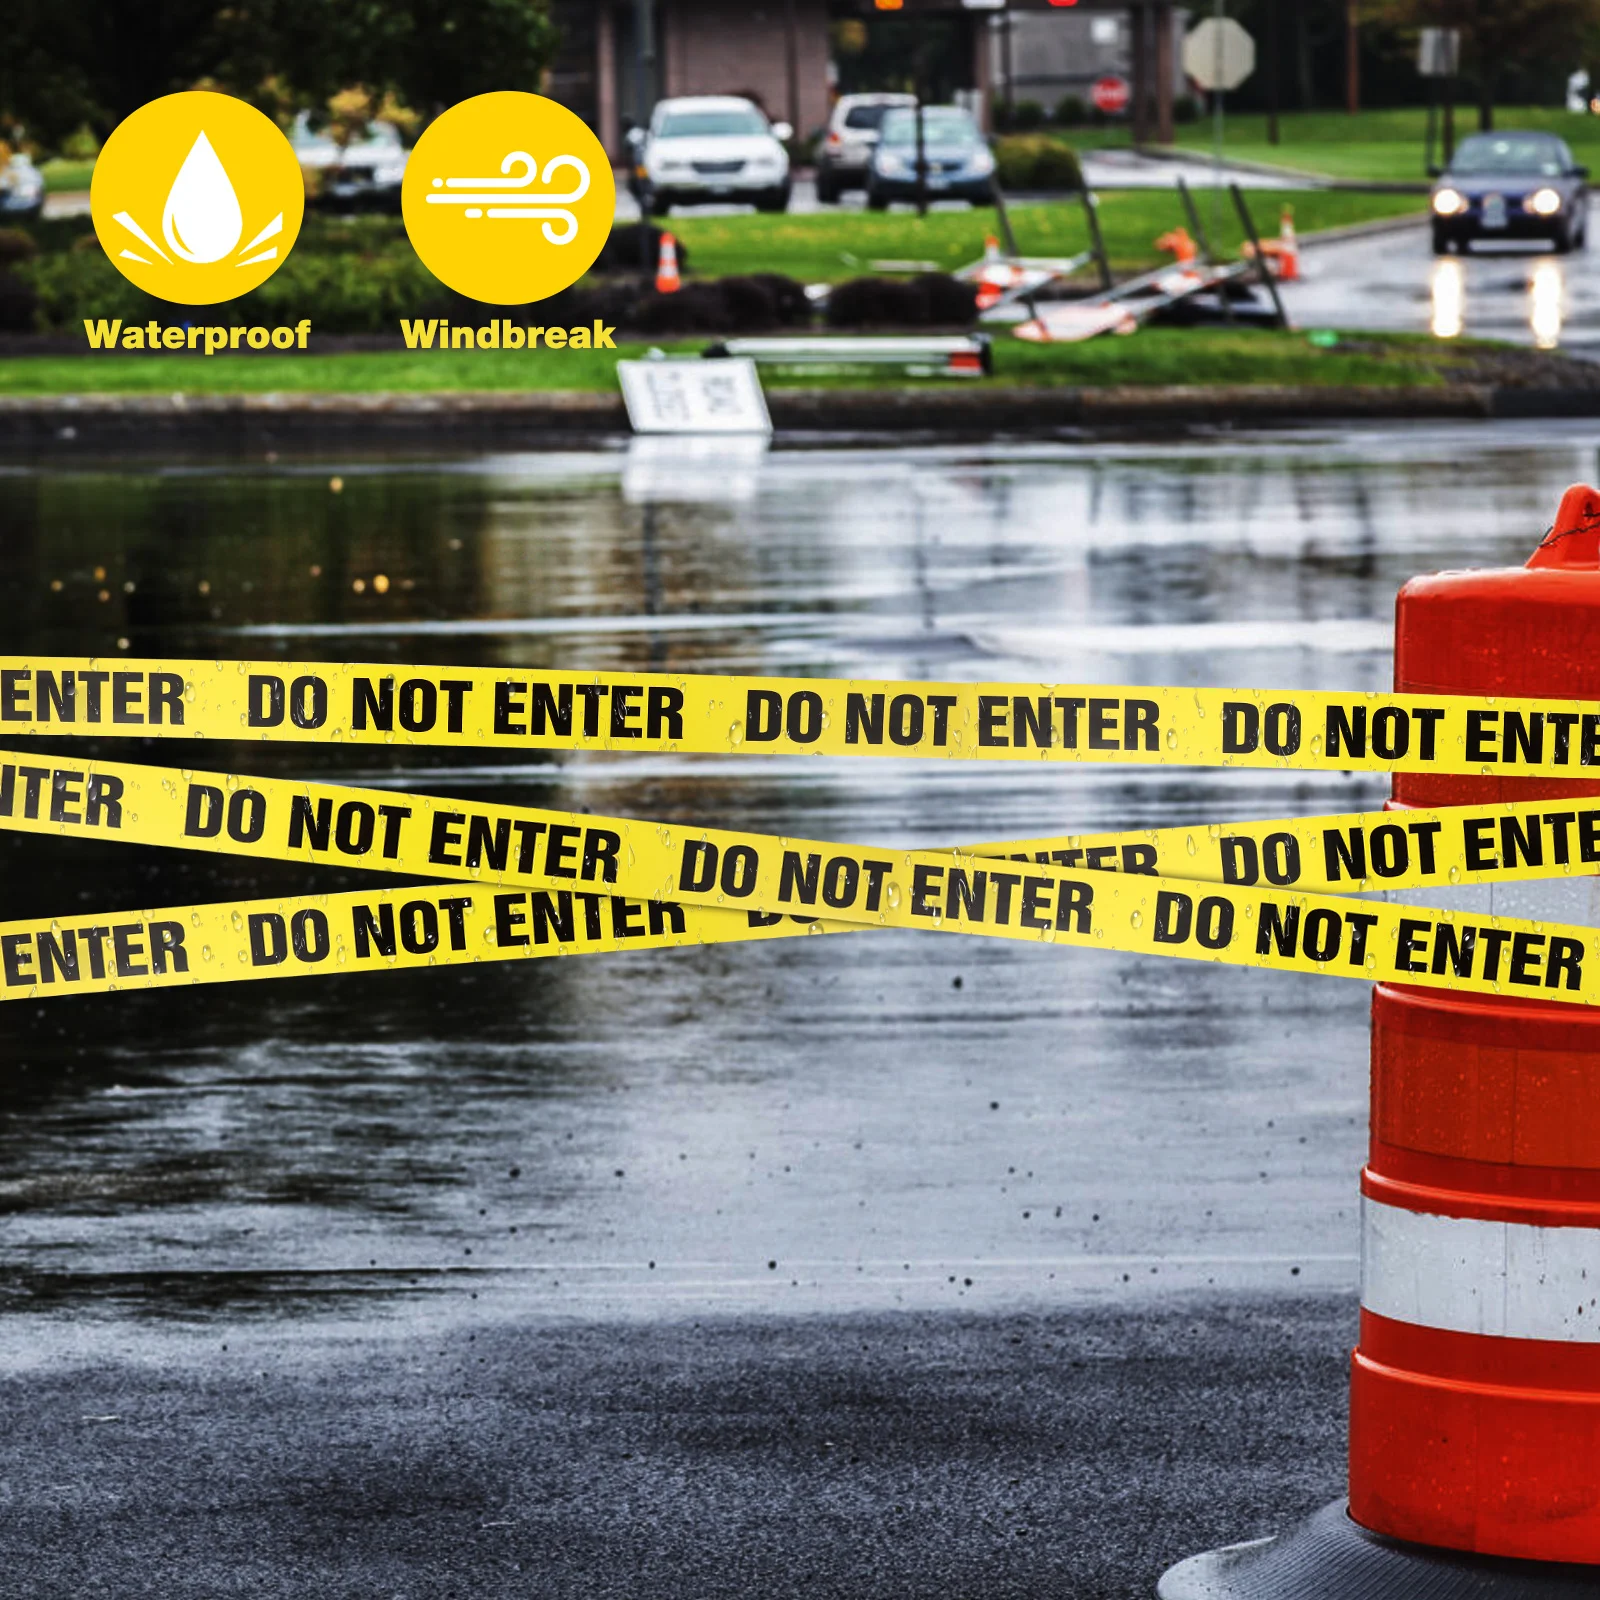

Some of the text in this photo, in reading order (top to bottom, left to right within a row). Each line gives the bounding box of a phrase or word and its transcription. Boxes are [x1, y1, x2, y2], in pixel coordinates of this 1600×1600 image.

[0, 670, 185, 725] ENTER
[248, 675, 328, 730] DO
[353, 678, 472, 733] NOT
[493, 682, 684, 740] ENTER
[745, 690, 823, 744] DO
[845, 693, 957, 746] NOT
[978, 695, 1160, 752] ENTER
[1222, 702, 1302, 757] DO
[1326, 706, 1445, 760] NOT
[3, 921, 189, 987] ENTER
[248, 909, 330, 967] DO
[352, 897, 472, 958] NOT
[494, 891, 687, 948] ENTER
[1220, 832, 1301, 886] DO
[1323, 821, 1442, 882] NOT
[184, 784, 267, 843] DO
[288, 796, 412, 860] NOT
[428, 810, 621, 884] ENTER
[679, 839, 759, 898] DO
[778, 851, 893, 912] NOT
[910, 865, 1094, 934] ENTER
[1153, 890, 1235, 950] DO
[1256, 902, 1379, 966] NOT
[1395, 918, 1585, 990] ENTER
